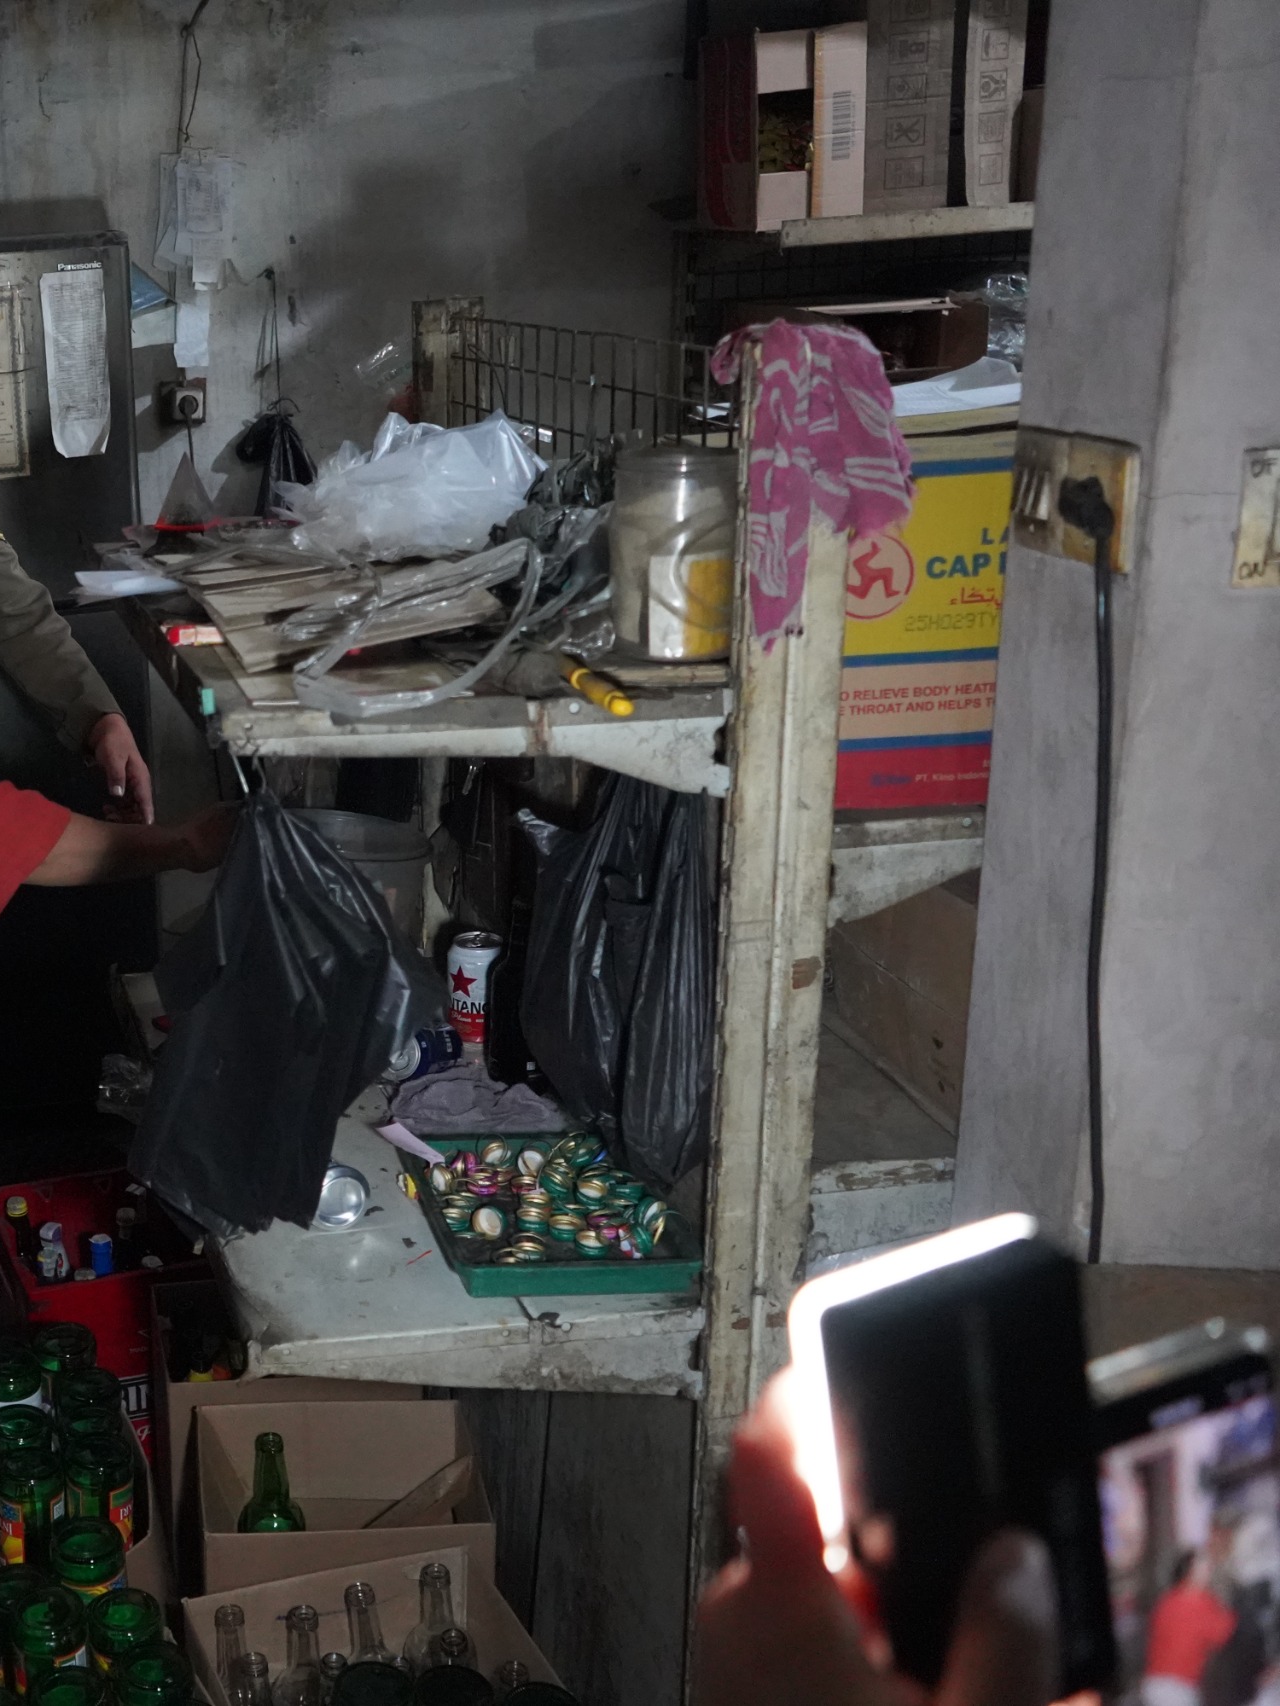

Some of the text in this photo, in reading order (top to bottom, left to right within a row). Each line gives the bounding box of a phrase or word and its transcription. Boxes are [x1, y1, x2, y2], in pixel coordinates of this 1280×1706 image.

[57, 260, 103, 271] Panasonic
[925, 553, 992, 579] CAP
[853, 688, 909, 701] RELIEVE
[913, 685, 951, 697] BODY
[955, 682, 996, 694] HEATI
[849, 702, 902, 716] THROAT
[906, 701, 935, 713] AND
[938, 698, 982, 711] HELPS
